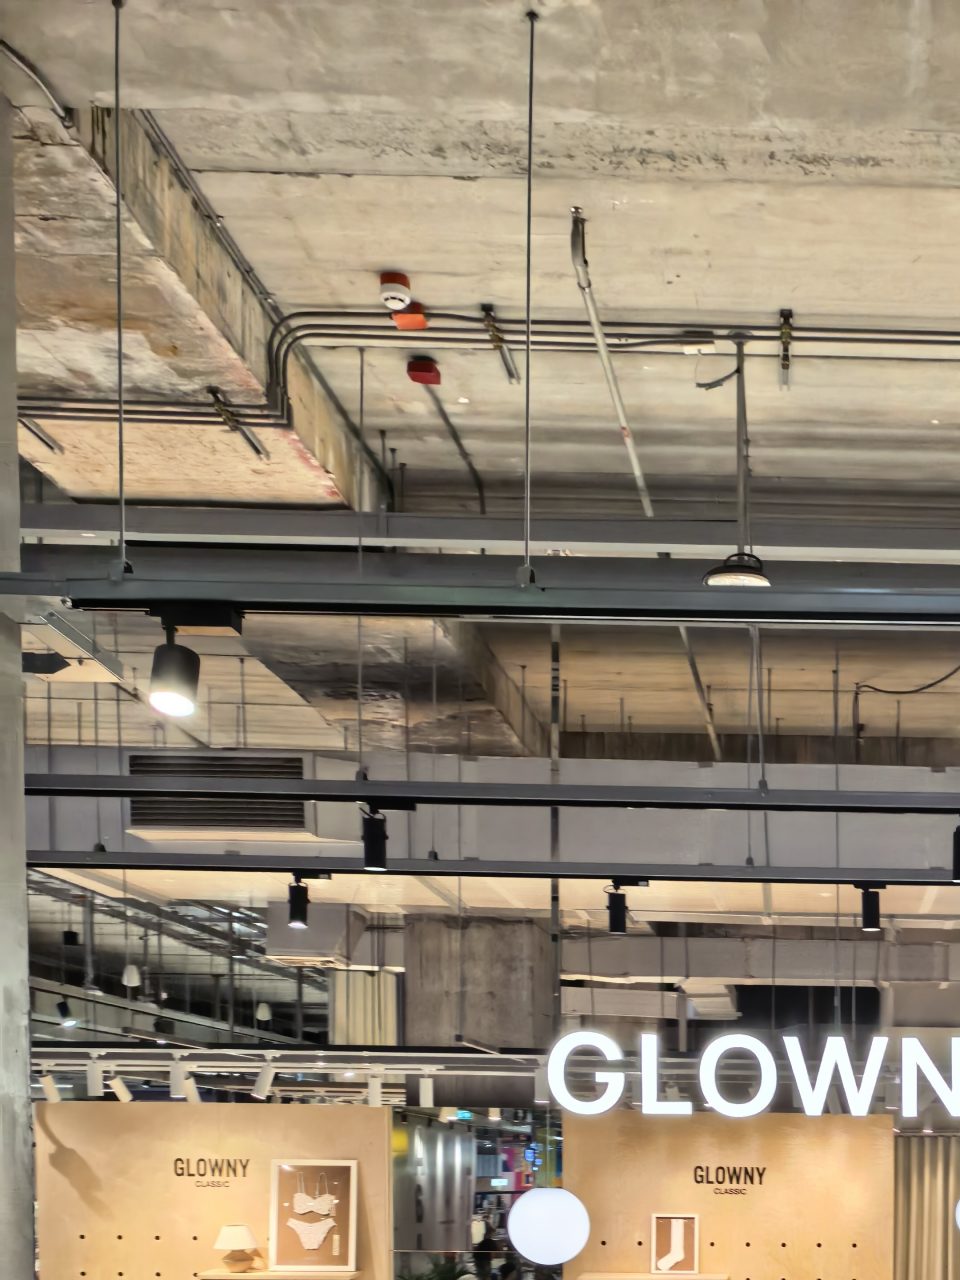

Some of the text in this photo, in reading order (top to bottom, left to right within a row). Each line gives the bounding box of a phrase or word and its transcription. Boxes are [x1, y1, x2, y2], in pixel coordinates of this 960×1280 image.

[174, 1157, 250, 1177] GLOWNY
[694, 1165, 767, 1185] GLOWNY
[194, 1180, 231, 1188] CLASSIC
[713, 1187, 748, 1196] CLASSIC
